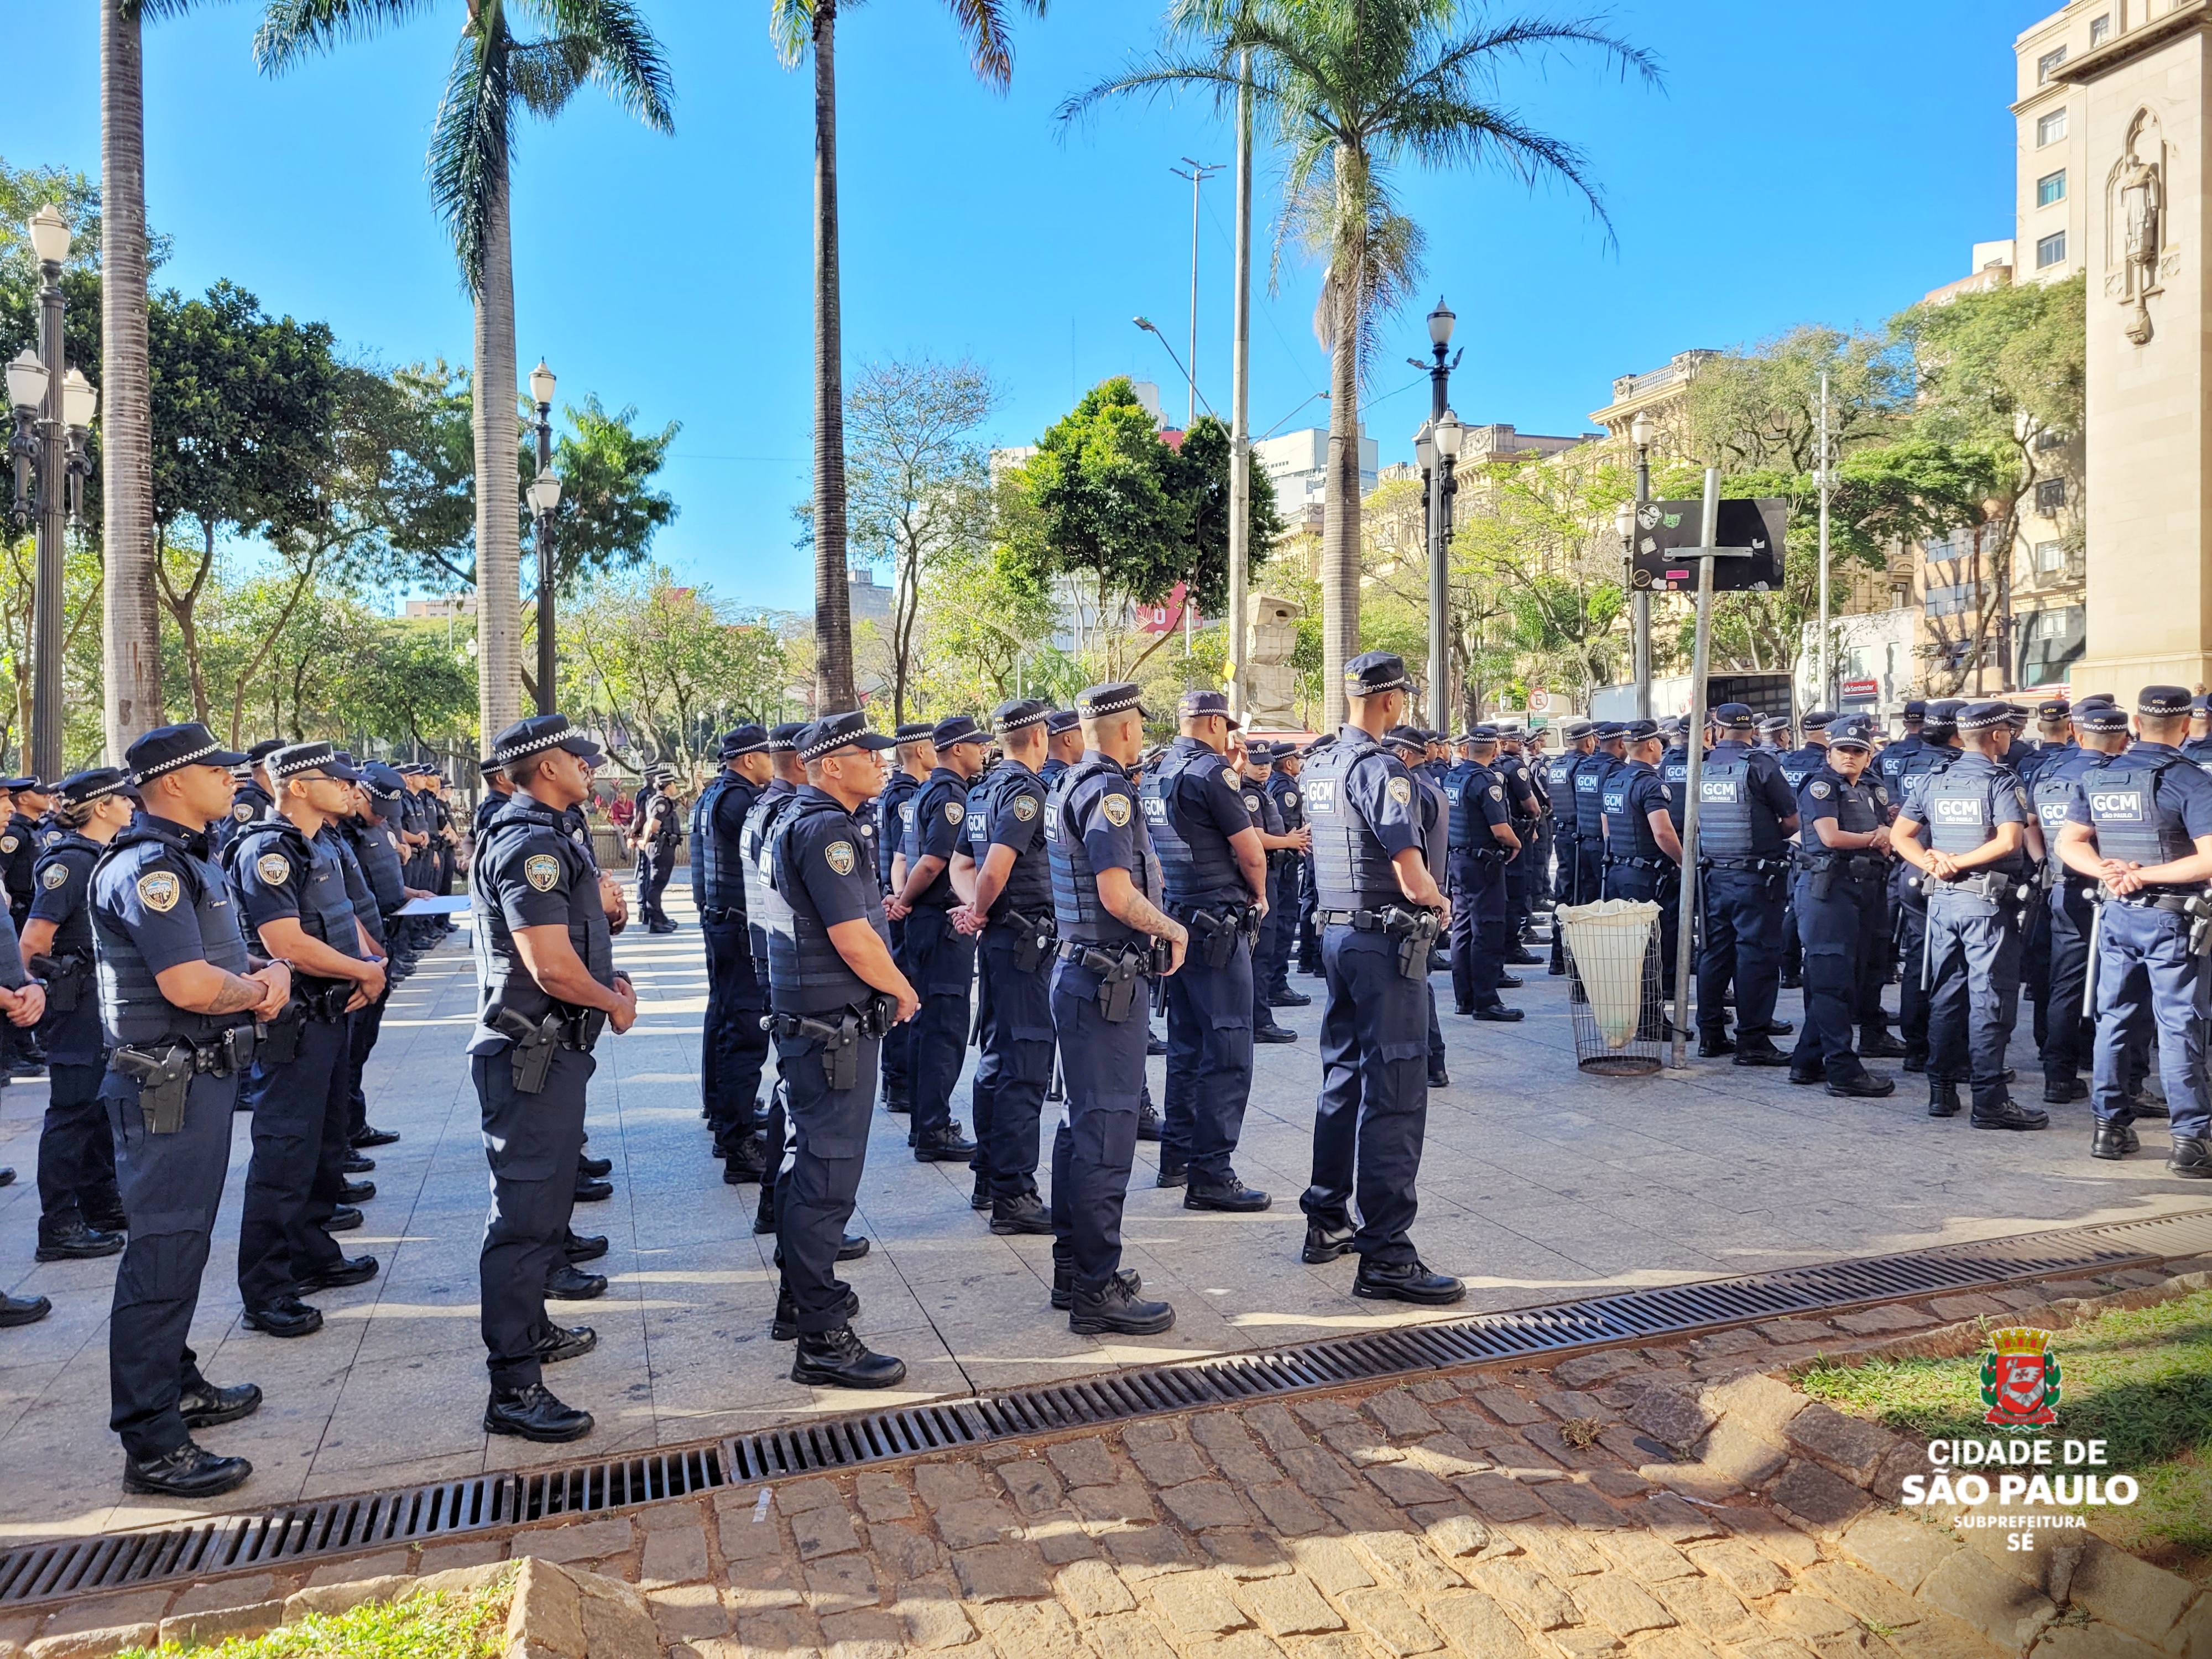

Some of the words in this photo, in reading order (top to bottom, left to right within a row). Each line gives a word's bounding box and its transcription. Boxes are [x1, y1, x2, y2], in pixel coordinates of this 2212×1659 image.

[1345, 672, 1359, 681] GCM
[1885, 760, 1900, 769] GC
[1551, 769, 1566, 779] GCM
[1577, 776, 1597, 787] GCM
[1903, 776, 1922, 789] GC
[1309, 781, 1333, 801] GCM
[1703, 783, 1734, 795] GCM
[1604, 795, 1622, 807] GCM
[2093, 794, 2137, 811] GCM
[1144, 800, 1165, 816] GCM
[1938, 801, 1978, 816] GCM
[968, 815, 985, 832] GCM
[1045, 807, 1057, 830] GCM
